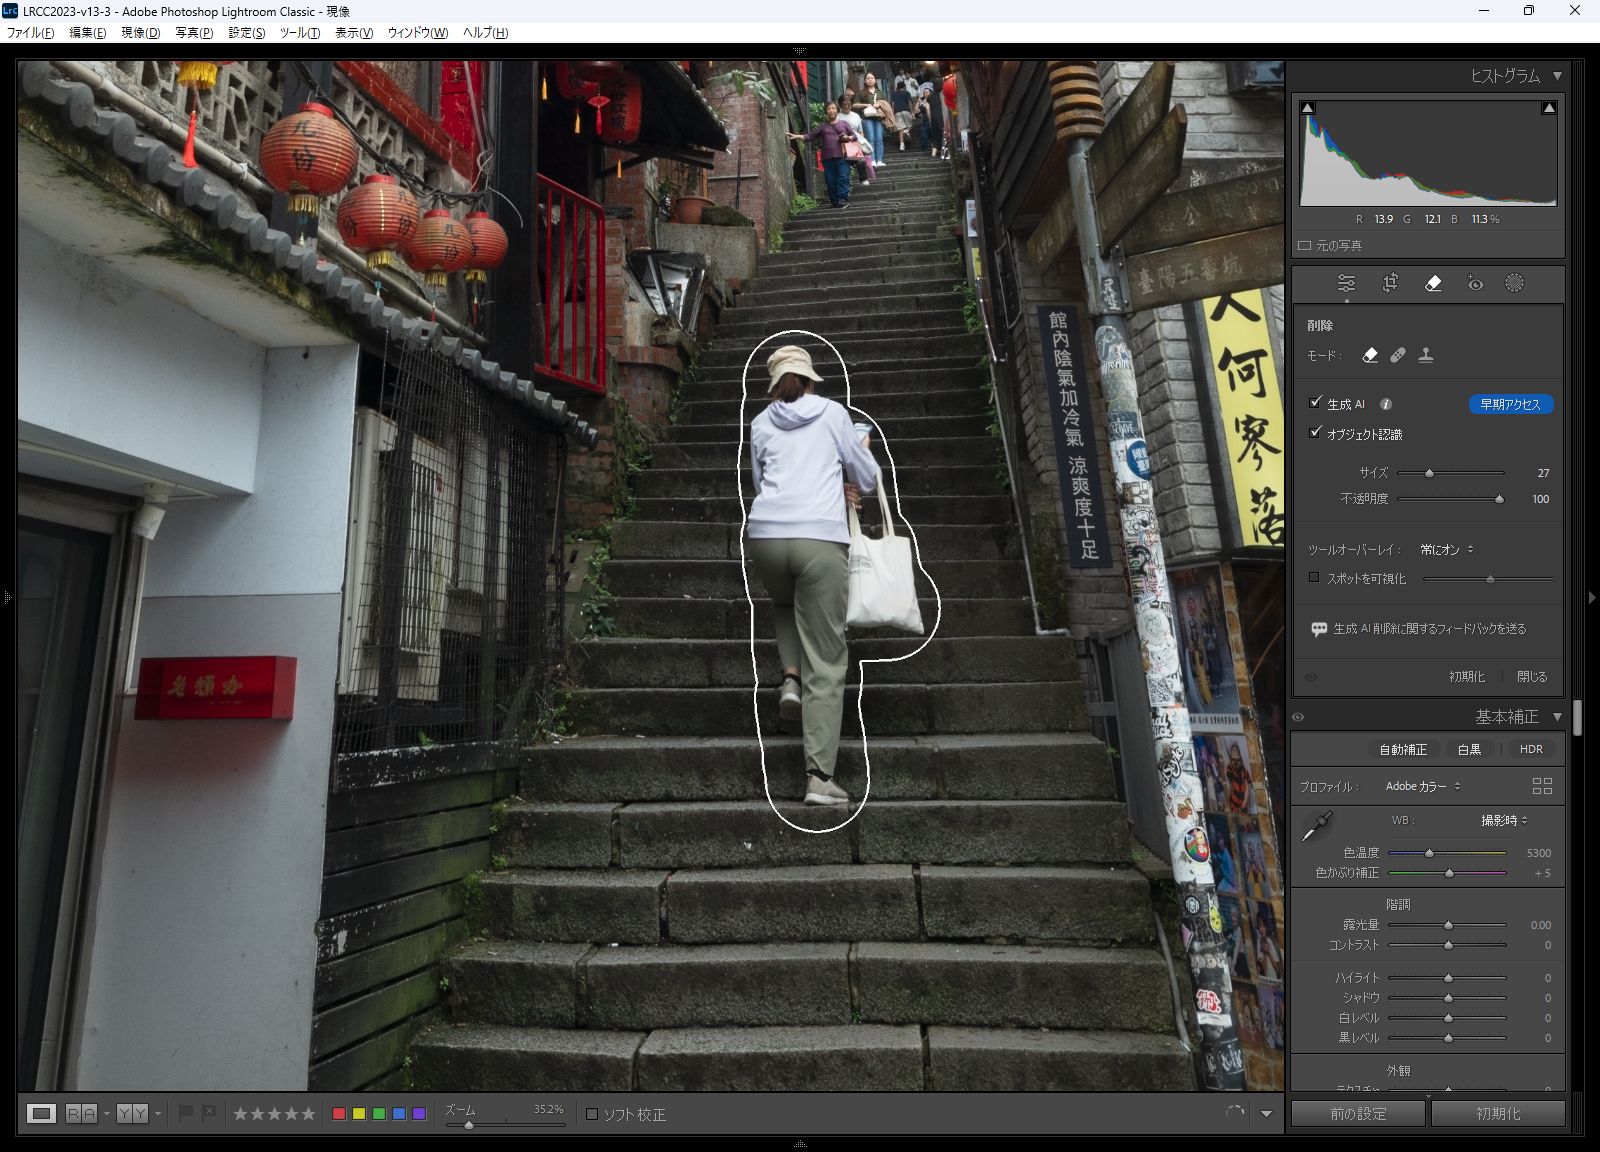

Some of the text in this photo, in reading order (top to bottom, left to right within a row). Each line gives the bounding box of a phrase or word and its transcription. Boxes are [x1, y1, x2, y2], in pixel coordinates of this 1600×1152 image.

[23, 6, 111, 17] LRCC2023-v13-3
[121, 6, 158, 17] Adobe
[161, 6, 219, 20] Photoshop
[221, 6, 277, 20] Lightroom
[279, 6, 316, 17] Classic
[326, 5, 351, 18] 現像
[7, 26, 55, 40] ファイル(F)
[69, 26, 107, 40] 編集(E)
[121, 26, 161, 40] 現像(D)
[175, 26, 214, 40] 写真(P)
[228, 26, 266, 40] 設定(S)
[280, 26, 321, 40] ツール(T)
[335, 26, 374, 40] 表示(V)
[388, 25, 449, 40] ウィンドウ(W)
[463, 25, 509, 40] ヘルプ(H)
[1472, 67, 1541, 84] ヒストグラム
[1356, 214, 1363, 224] R
[1374, 214, 1394, 224] 13.9
[1402, 214, 1411, 224] G
[1424, 214, 1441, 224] 12.1
[1451, 214, 1458, 224] B
[1471, 214, 1489, 224] 11.3
[1316, 239, 1363, 252] 元の写真
[1307, 319, 1334, 332] 削除
[1327, 398, 1365, 411] 生成 AI
[1480, 398, 1541, 411] 早期アクセス
[1327, 428, 1403, 441] オブジェクト認識
[1359, 466, 1550, 479] サイズ 27
[1340, 492, 1550, 505] 不透明度 100
[1068, 455, 1100, 561] 涼爽度十足
[1420, 543, 1460, 556] 常にオン
[1327, 572, 1407, 585] スポットを可視化
[1333, 622, 1527, 635] 生成 AI 削除に関するフィードバックを送る
[1449, 670, 1486, 683] 初期化
[1517, 670, 1548, 683] 閉じる
[1475, 708, 1540, 725] 基本補正
[1380, 743, 1428, 756] 自動補正
[1458, 743, 1482, 756] 白黒
[1520, 744, 1544, 754] HDR
[1385, 780, 1418, 791] Adobe
[1419, 780, 1447, 793] カラー
[1481, 814, 1518, 827] 撮影時
[1343, 846, 1552, 859] 色温度 5300
[1315, 866, 1380, 879] 色かぶり補正
[1386, 898, 1411, 911] 階調
[1343, 918, 1552, 931] 露光量 0.00
[1329, 938, 1552, 951] コントラスト 0
[1335, 971, 1552, 984] ハイライト 0
[1343, 991, 1552, 1004] シャドウ 0
[1339, 1011, 1552, 1024] 白レベル 0
[1338, 1031, 1552, 1044] 黒レベル 0
[1386, 1064, 1411, 1077] 外観
[445, 1103, 565, 1116] ズーム 35.2%
[1330, 1106, 1387, 1121] 前の設定
[1476, 1106, 1521, 1121] 初期化
